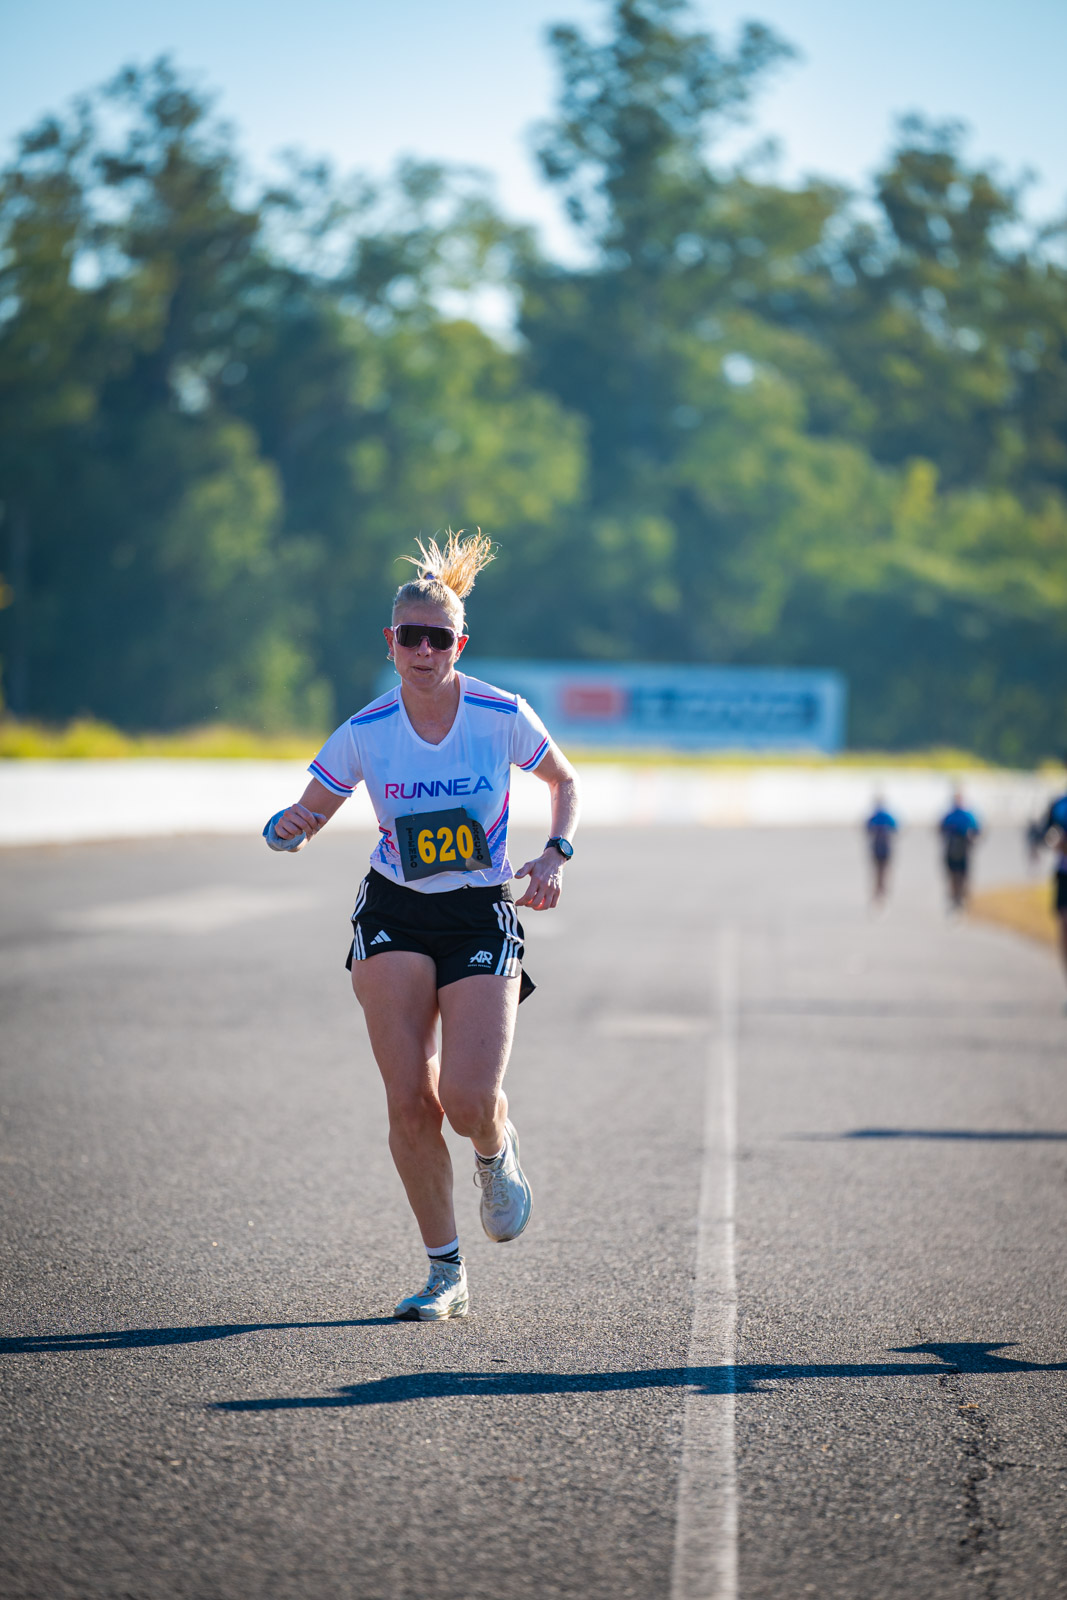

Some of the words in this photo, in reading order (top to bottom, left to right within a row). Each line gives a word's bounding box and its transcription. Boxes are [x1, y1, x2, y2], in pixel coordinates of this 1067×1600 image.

[385, 776, 493, 799] RUNNEA
[406, 827, 417, 868] TIEMPO
[418, 825, 474, 864] 620
